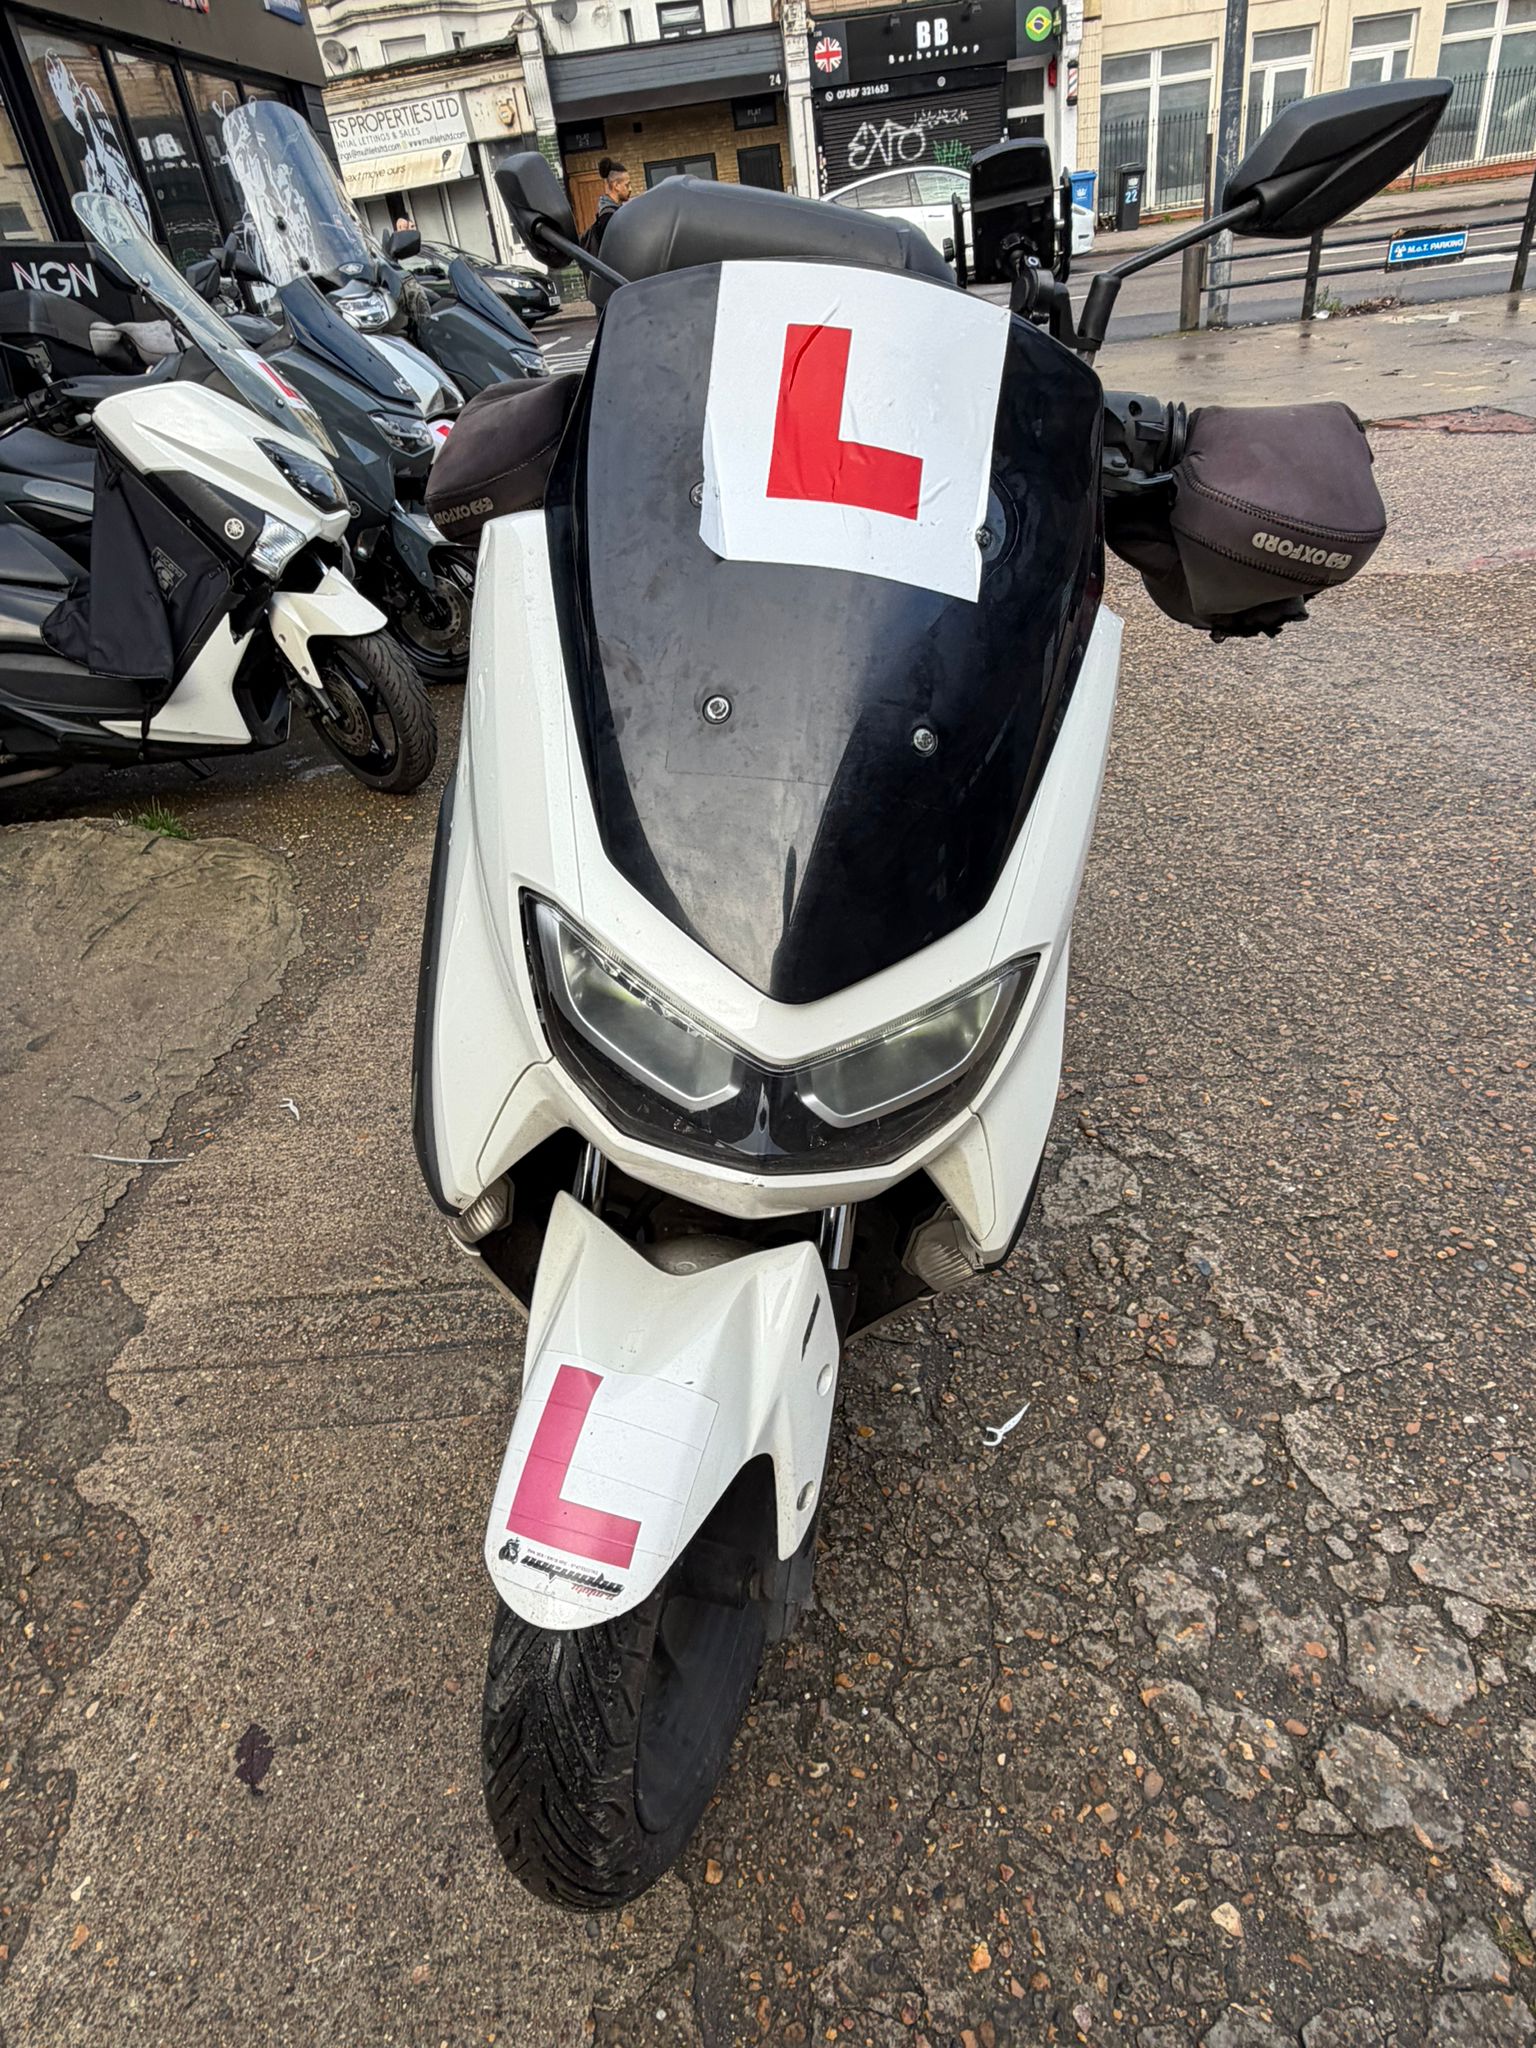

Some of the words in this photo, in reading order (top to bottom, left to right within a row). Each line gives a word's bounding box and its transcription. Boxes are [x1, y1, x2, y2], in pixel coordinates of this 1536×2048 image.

[916, 18, 949, 49] BB
[888, 44, 980, 64] Barbershop
[769, 73, 782, 87] 24
[836, 87, 860, 100] 07587
[861, 83, 889, 97] 321653
[348, 102, 432, 136] PROPERTIES
[432, 97, 460, 121] LTD
[358, 133, 390, 146] LETTINGS
[399, 127, 420, 138] SALES
[362, 168, 386, 181] move
[387, 164, 406, 176] ours
[1125, 189, 1138, 204] 22
[1430, 238, 1464, 250] PARKING
[11, 261, 98, 298] NGN
[766, 323, 924, 521] L
[1252, 531, 1328, 566] OXFORD
[505, 1364, 642, 1570] L
